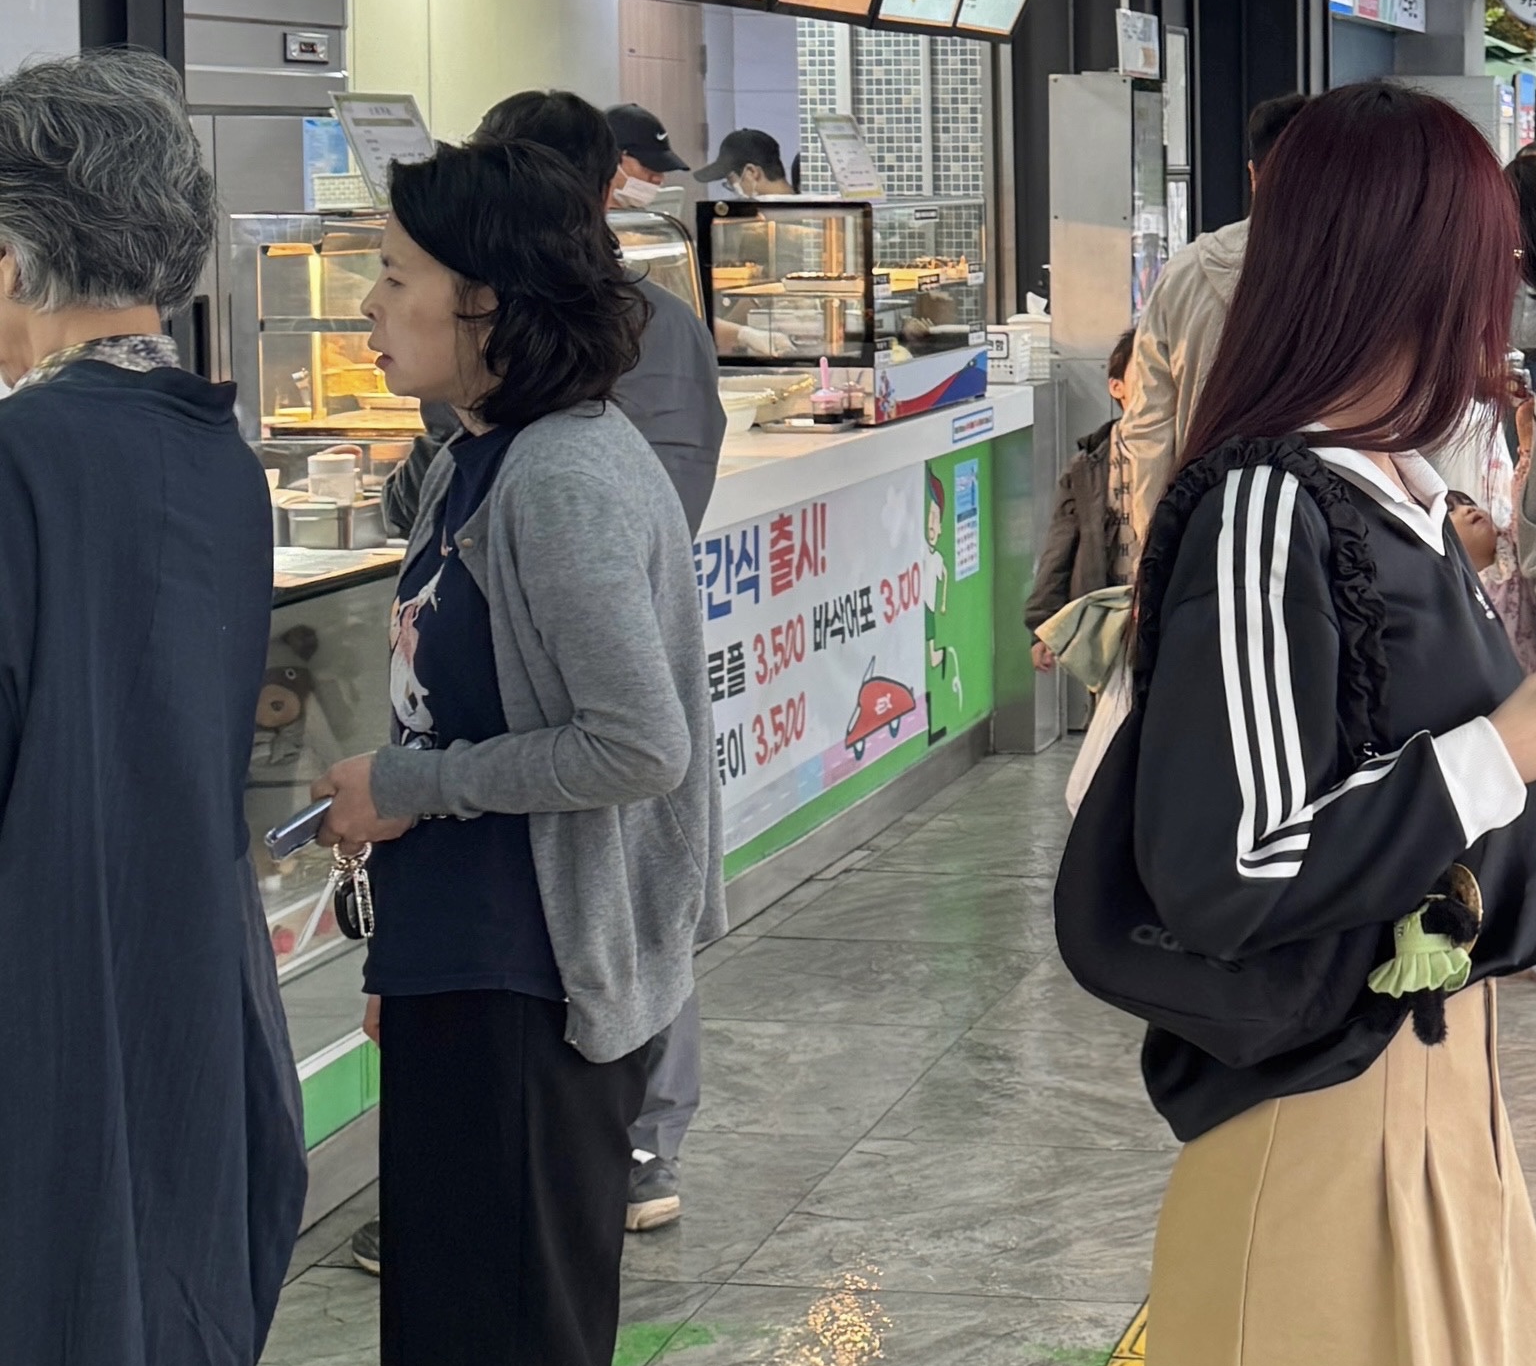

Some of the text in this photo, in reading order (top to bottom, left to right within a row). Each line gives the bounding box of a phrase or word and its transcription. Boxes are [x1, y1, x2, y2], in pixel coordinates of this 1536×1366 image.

[769, 502, 827, 597] 출시!
[753, 613, 806, 685] 3,500
[813, 586, 877, 652] 바삭어포
[752, 692, 806, 767] 3,500
